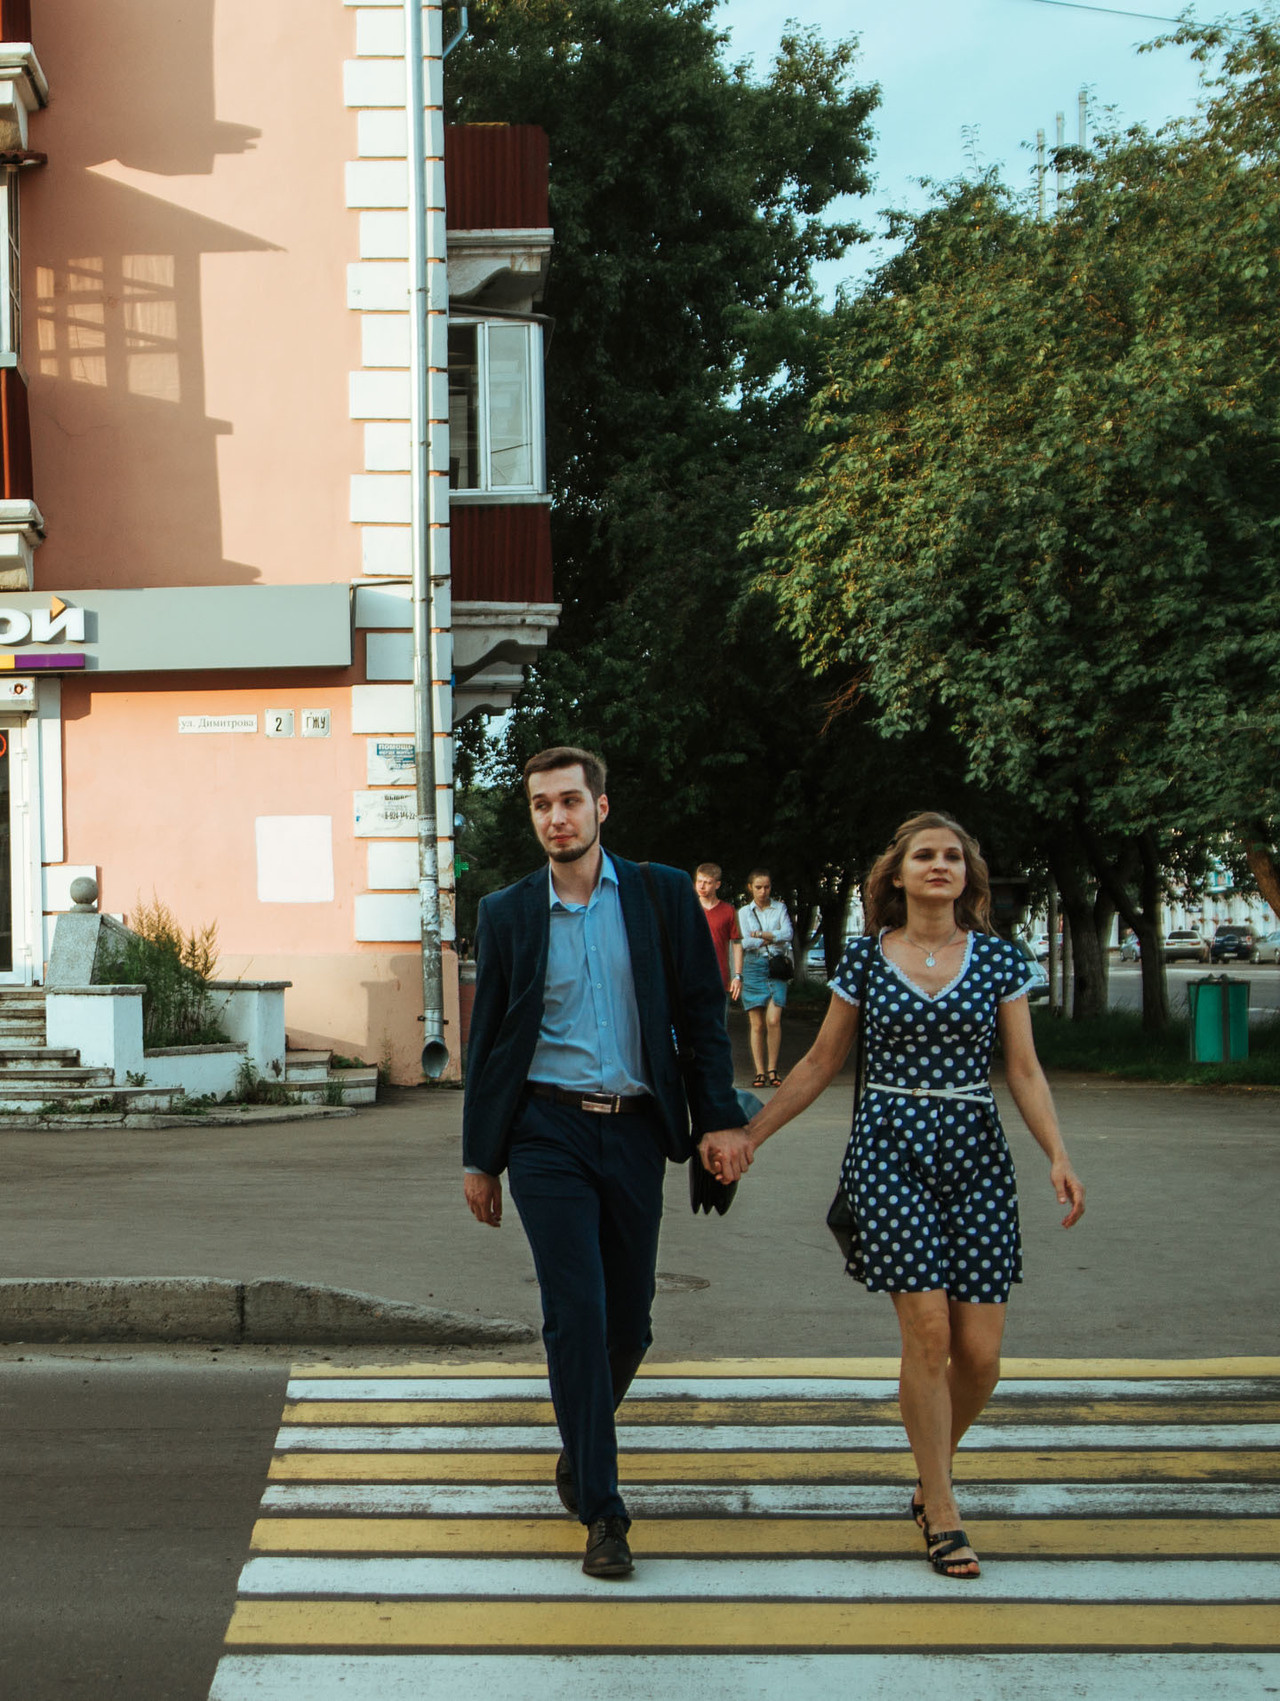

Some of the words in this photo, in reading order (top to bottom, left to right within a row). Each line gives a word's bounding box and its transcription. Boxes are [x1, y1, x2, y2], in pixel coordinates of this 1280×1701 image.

[181, 720, 195, 729] ул.
[198, 718, 254, 729] Димитрова
[275, 716, 283, 732] 2
